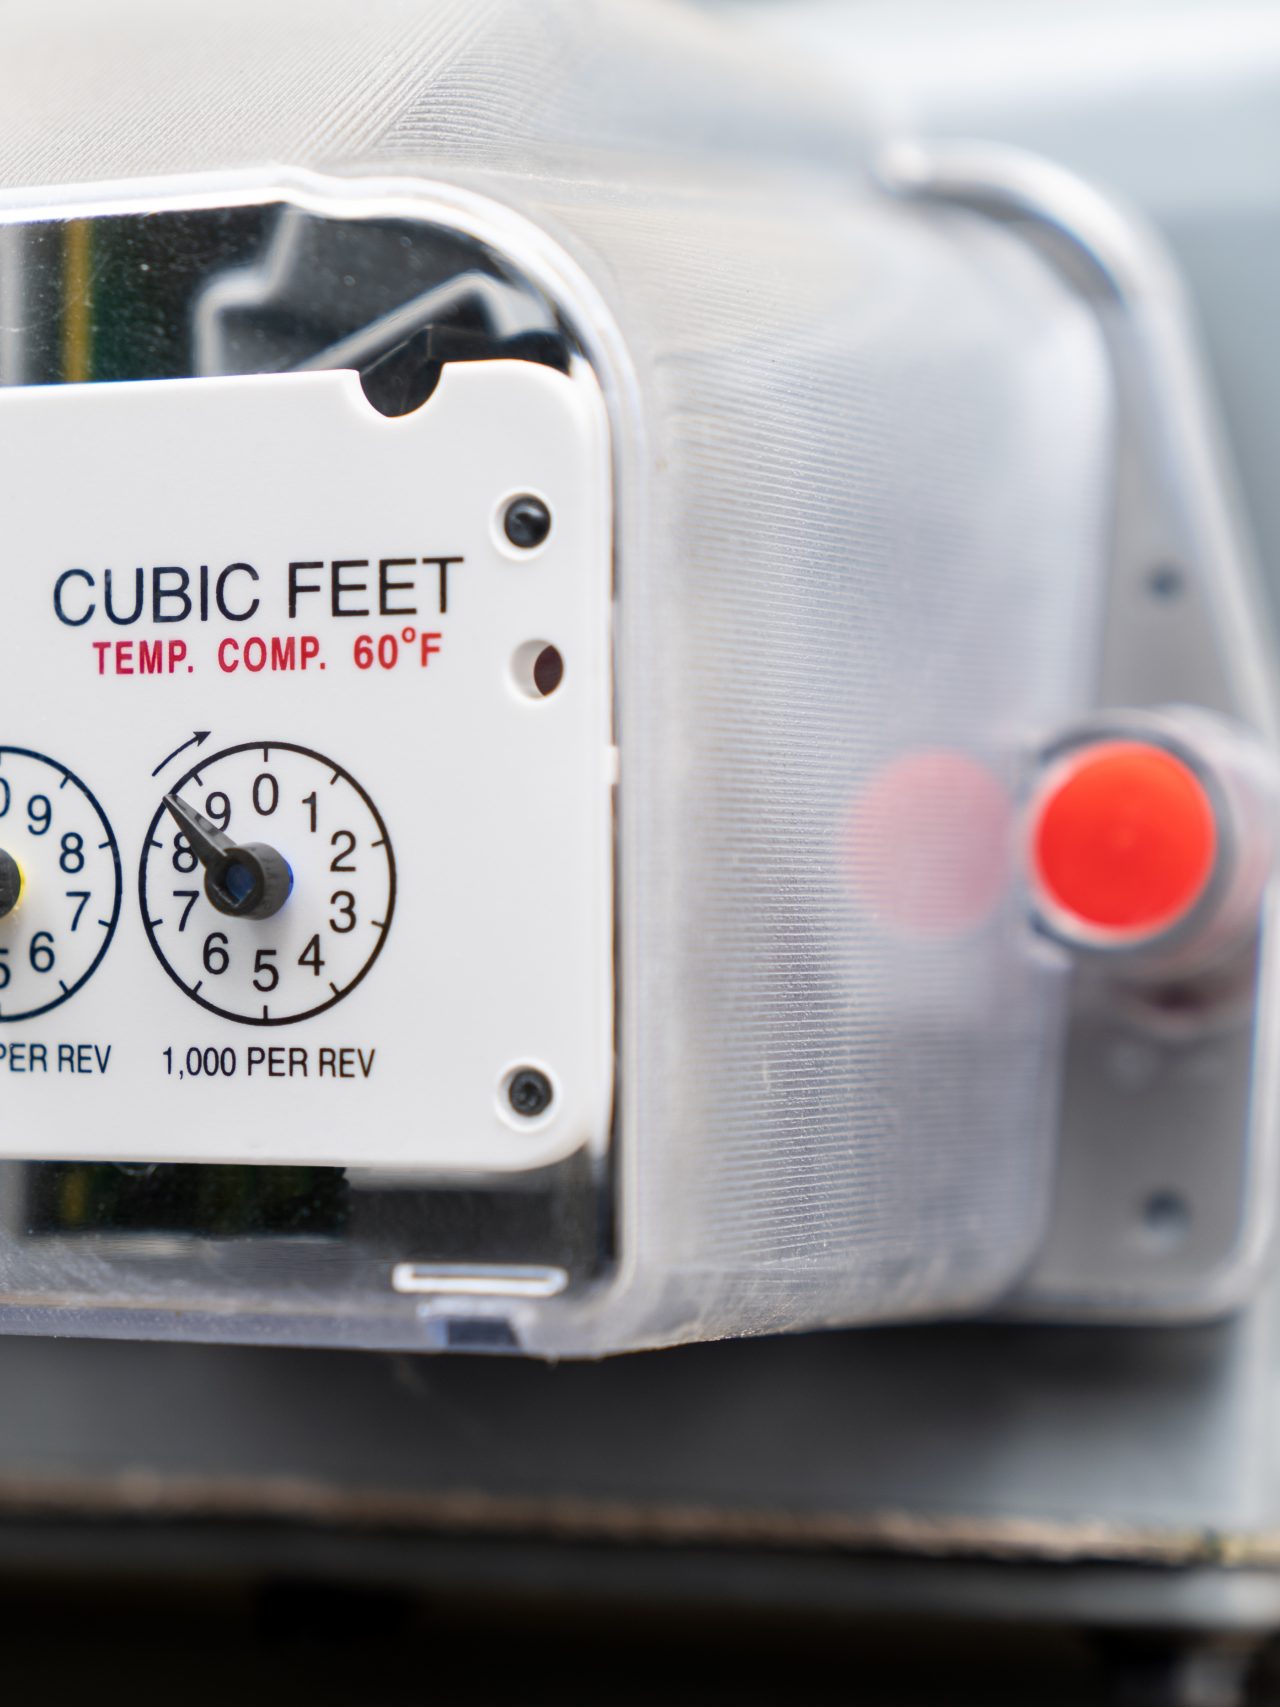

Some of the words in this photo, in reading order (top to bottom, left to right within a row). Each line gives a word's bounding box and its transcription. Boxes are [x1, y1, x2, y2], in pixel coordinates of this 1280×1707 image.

[53, 562, 260, 627] CUBIC
[288, 556, 465, 619] FEET
[92, 639, 195, 675] TEMP.
[217, 635, 327, 673] COMP.
[353, 626, 442, 670] 60°F
[205, 791, 232, 832] 9
[252, 773, 280, 815] 0
[301, 792, 318, 833] 1
[26, 795, 53, 836] 9
[59, 832, 86, 874] 8
[172, 832, 199, 873] 8
[329, 830, 357, 872] 2
[66, 891, 91, 931] 7
[172, 891, 200, 932] 7
[328, 891, 358, 934] 3
[29, 931, 56, 973] 6
[202, 932, 230, 975] 6
[252, 950, 280, 992] 5
[297, 934, 326, 976] 4
[58, 1045, 112, 1075] REV
[162, 1046, 236, 1082] 1,000
[247, 1048, 308, 1078] PER
[318, 1048, 376, 1079] REV
